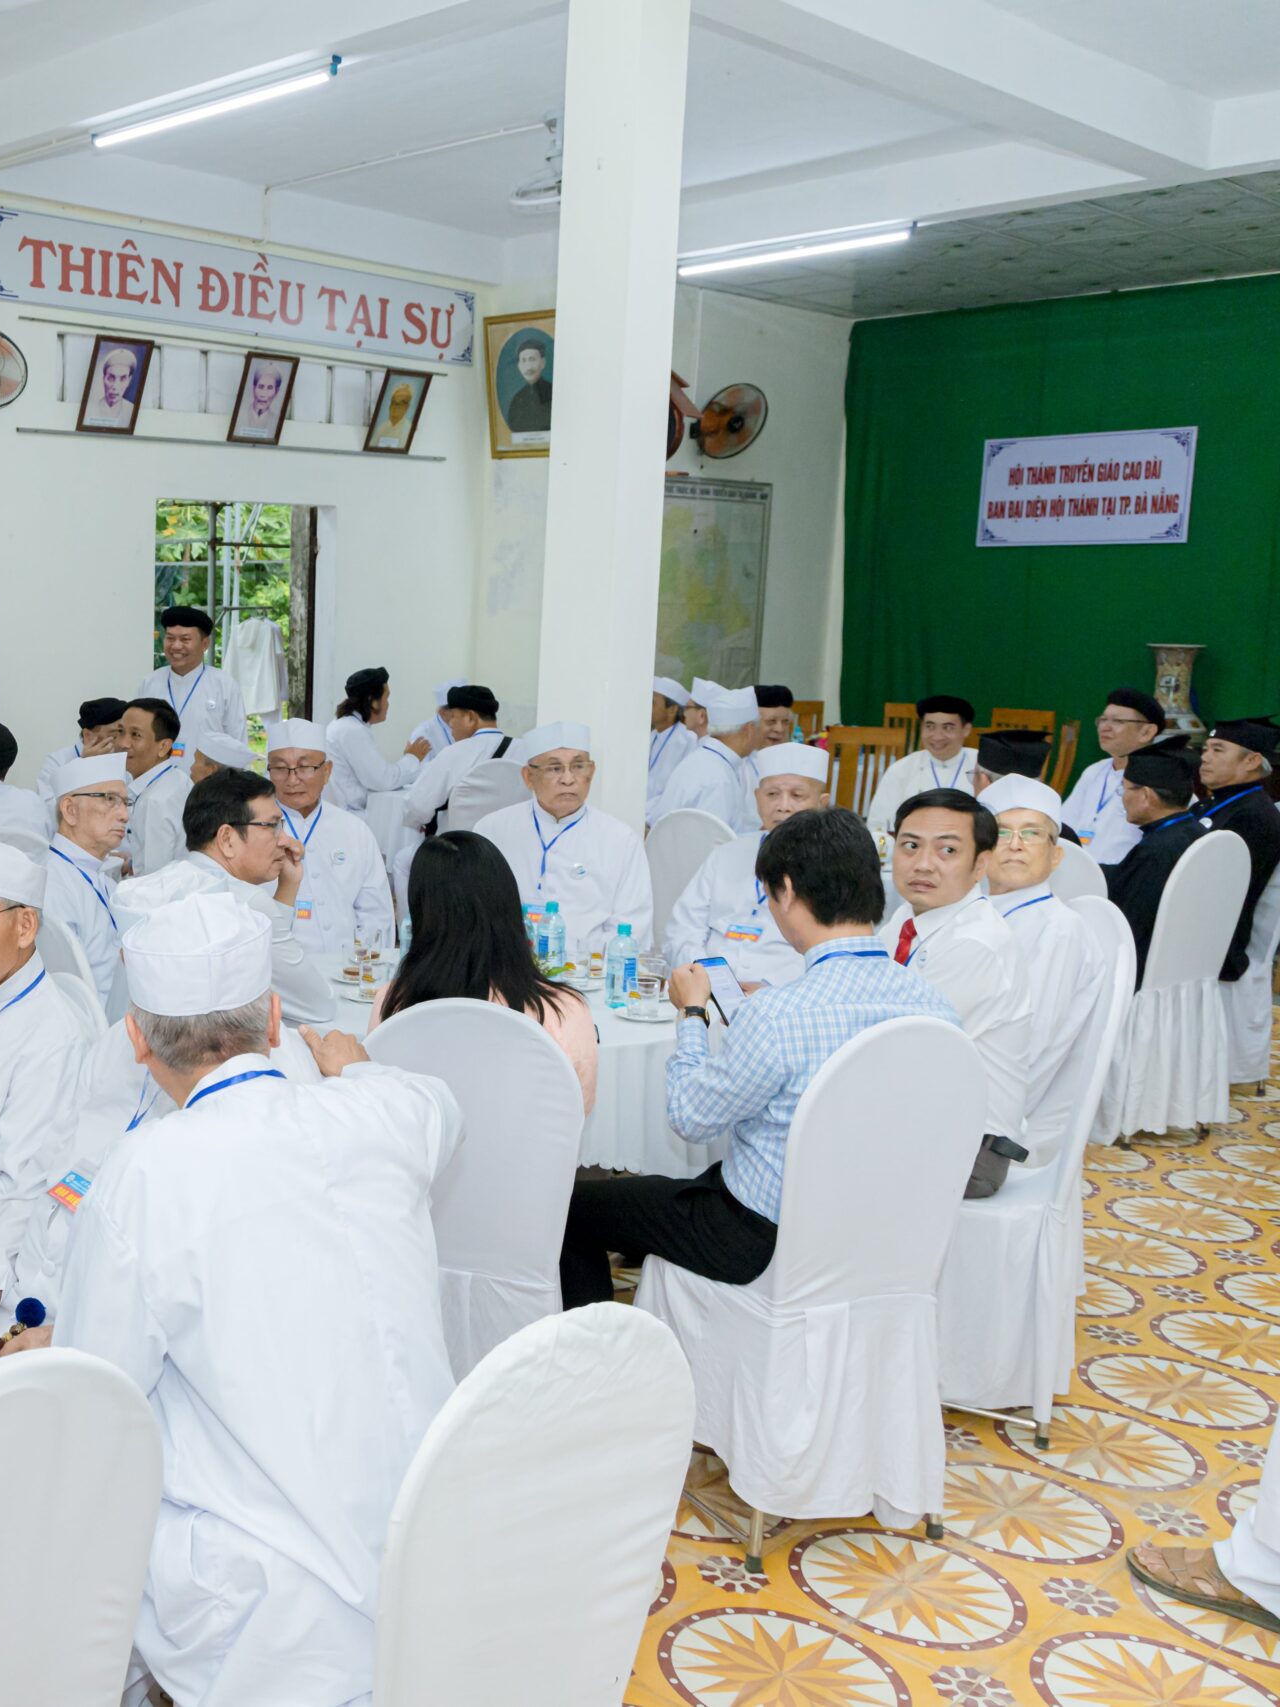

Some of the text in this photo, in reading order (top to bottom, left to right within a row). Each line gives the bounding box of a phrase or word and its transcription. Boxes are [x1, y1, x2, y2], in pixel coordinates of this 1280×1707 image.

[18, 235, 456, 361] THIÊN ĐIỀU TẠI SỰ
[1008, 463, 1024, 489] HỘI
[1027, 462, 1056, 486] THÁNH
[1097, 458, 1120, 482] GIÁO
[1122, 461, 1142, 481] CAO
[987, 501, 1006, 519] BAN
[1049, 494, 1065, 522] HỘI
[1068, 493, 1099, 517] THÁNH
[1101, 496, 1117, 520] TẠI
[1119, 495, 1132, 516] TP.
